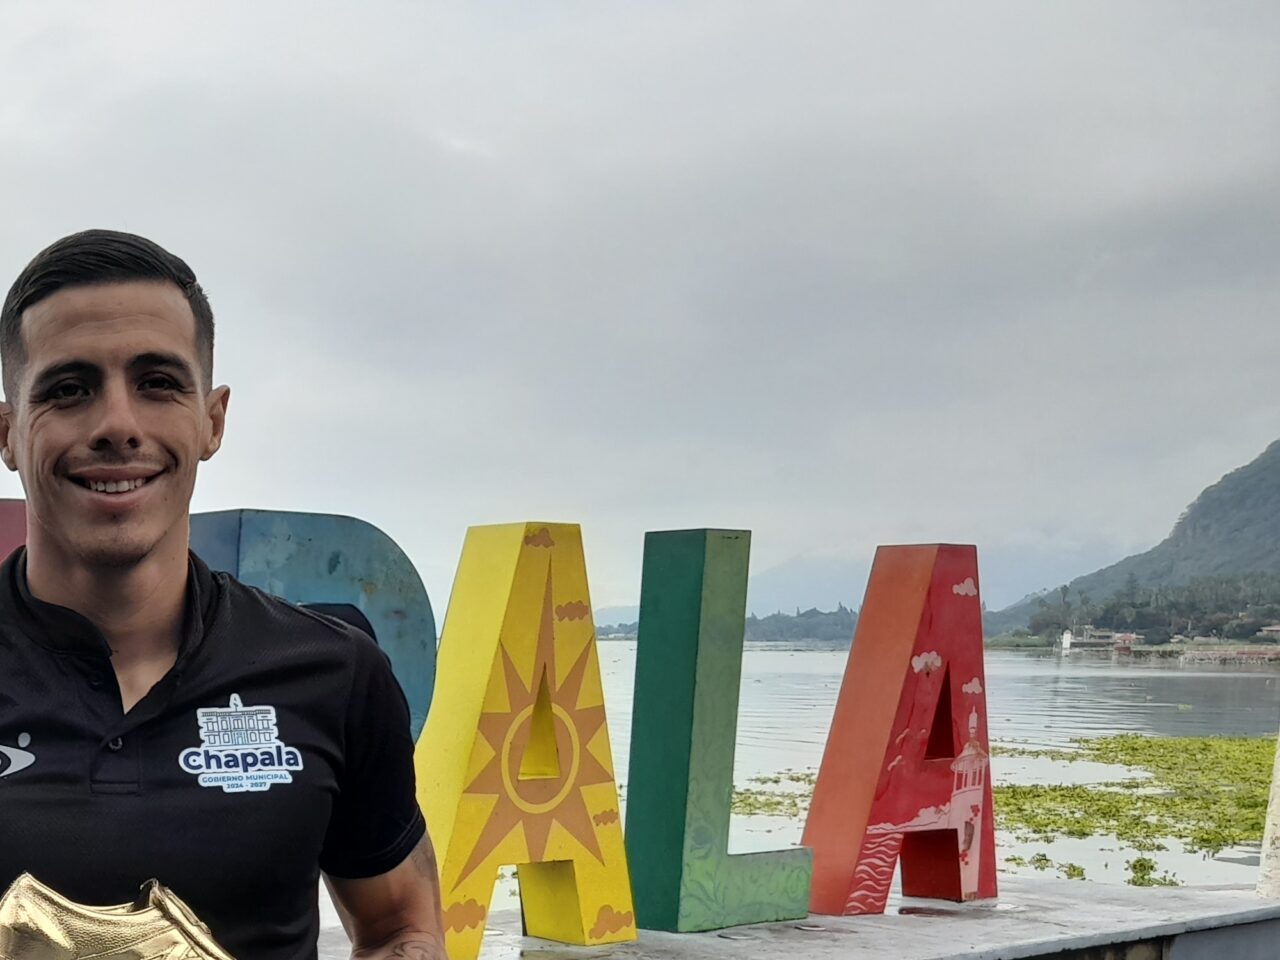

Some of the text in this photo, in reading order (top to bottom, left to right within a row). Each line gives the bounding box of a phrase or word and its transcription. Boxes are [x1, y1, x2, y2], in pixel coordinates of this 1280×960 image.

[182, 745, 300, 773] Chapala
[202, 773, 289, 783] GOBIERNO MUNICIPAL
